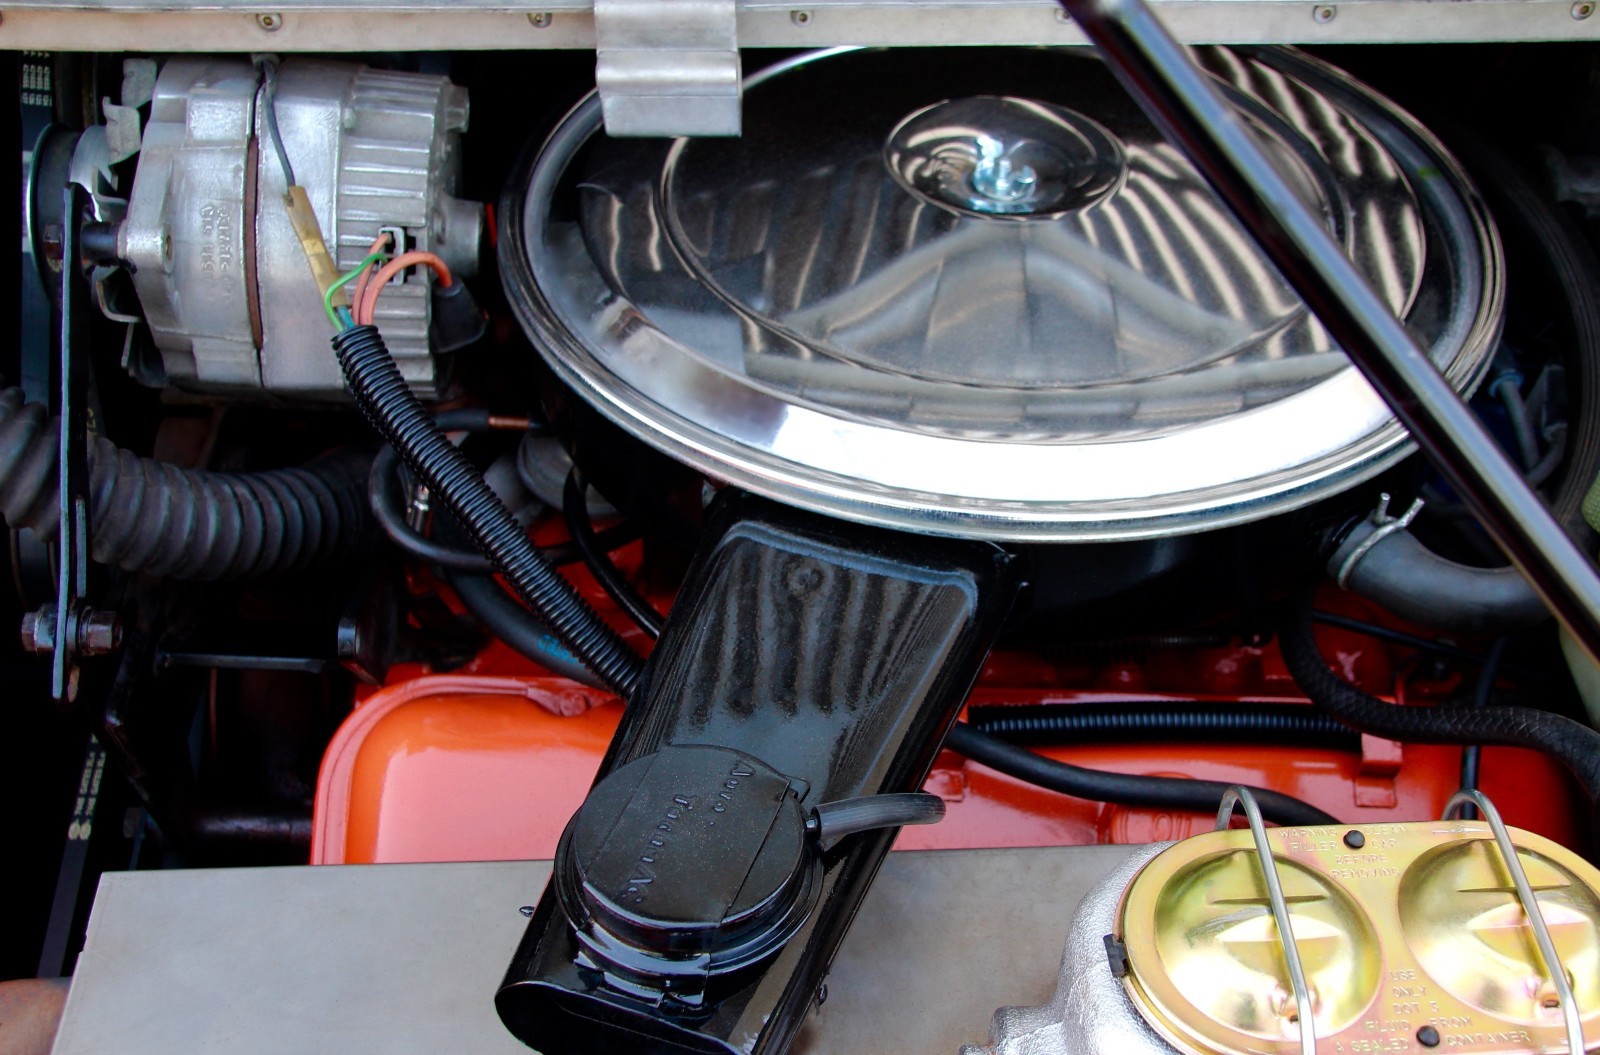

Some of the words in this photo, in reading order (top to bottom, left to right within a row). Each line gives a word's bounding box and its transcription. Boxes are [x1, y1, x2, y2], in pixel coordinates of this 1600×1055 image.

[1279, 826, 1338, 839] WARNING
[1362, 824, 1408, 836] CLEAN
[1289, 841, 1339, 853] FILLER
[1371, 838, 1397, 849] CAP
[1335, 853, 1389, 865] BEFORE
[1331, 867, 1401, 879] REMOVING
[1389, 968, 1418, 981] USE
[1392, 985, 1427, 998] ONLY
[1393, 1001, 1421, 1015] DOT
[1365, 1019, 1412, 1033] FLUID
[1429, 1015, 1473, 1029] FROM
[1351, 1037, 1409, 1053] SEALED
[1445, 1030, 1532, 1047] CONTAINER
